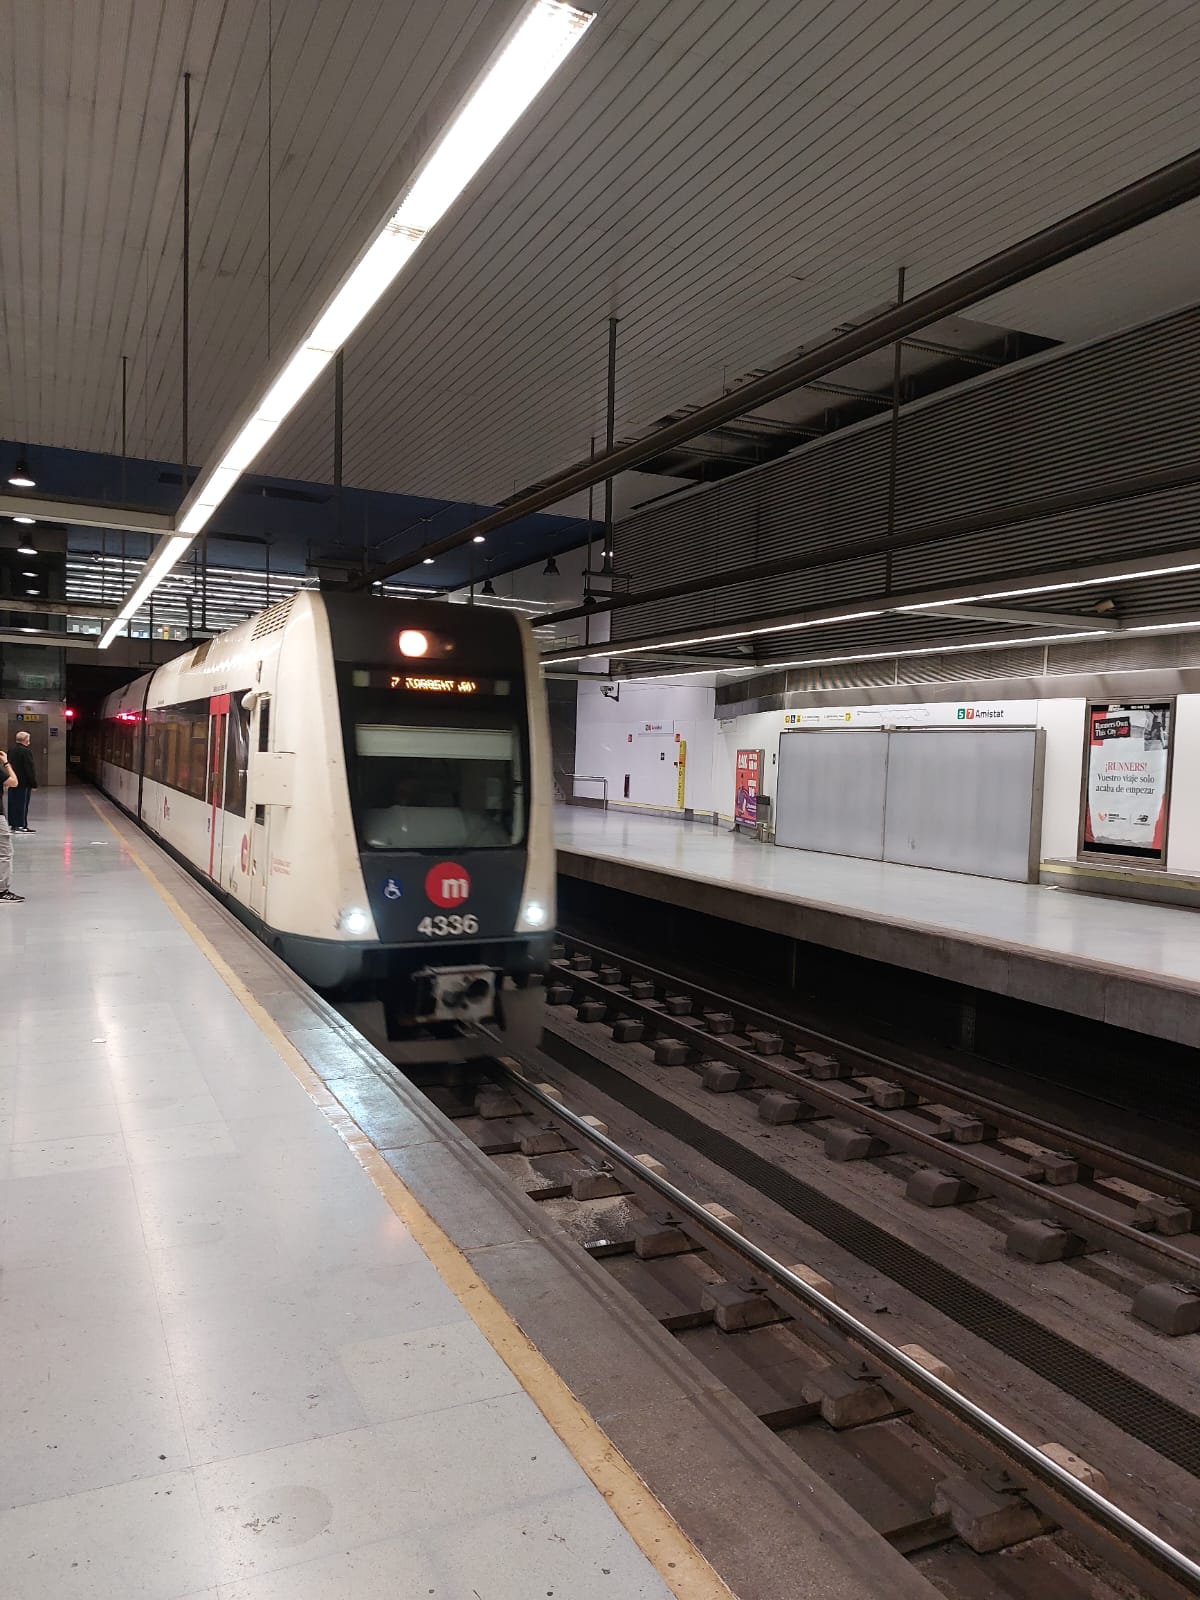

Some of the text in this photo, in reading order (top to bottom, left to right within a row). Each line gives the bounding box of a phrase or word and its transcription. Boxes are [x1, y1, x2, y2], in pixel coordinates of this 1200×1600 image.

[405, 678, 455, 691] TORRENT
[958, 709, 1004, 719] 5 7 Amistat
[1095, 722, 1115, 730] Runners
[1095, 729, 1106, 737] This
[1105, 762, 1148, 772] ¡RUNNERS!
[1097, 773, 1155, 784] Vuestro viaje solo
[1095, 784, 1114, 792] acaba
[1126, 786, 1155, 795] empezar
[441, 878, 469, 898] m
[417, 914, 479, 936] 4336
